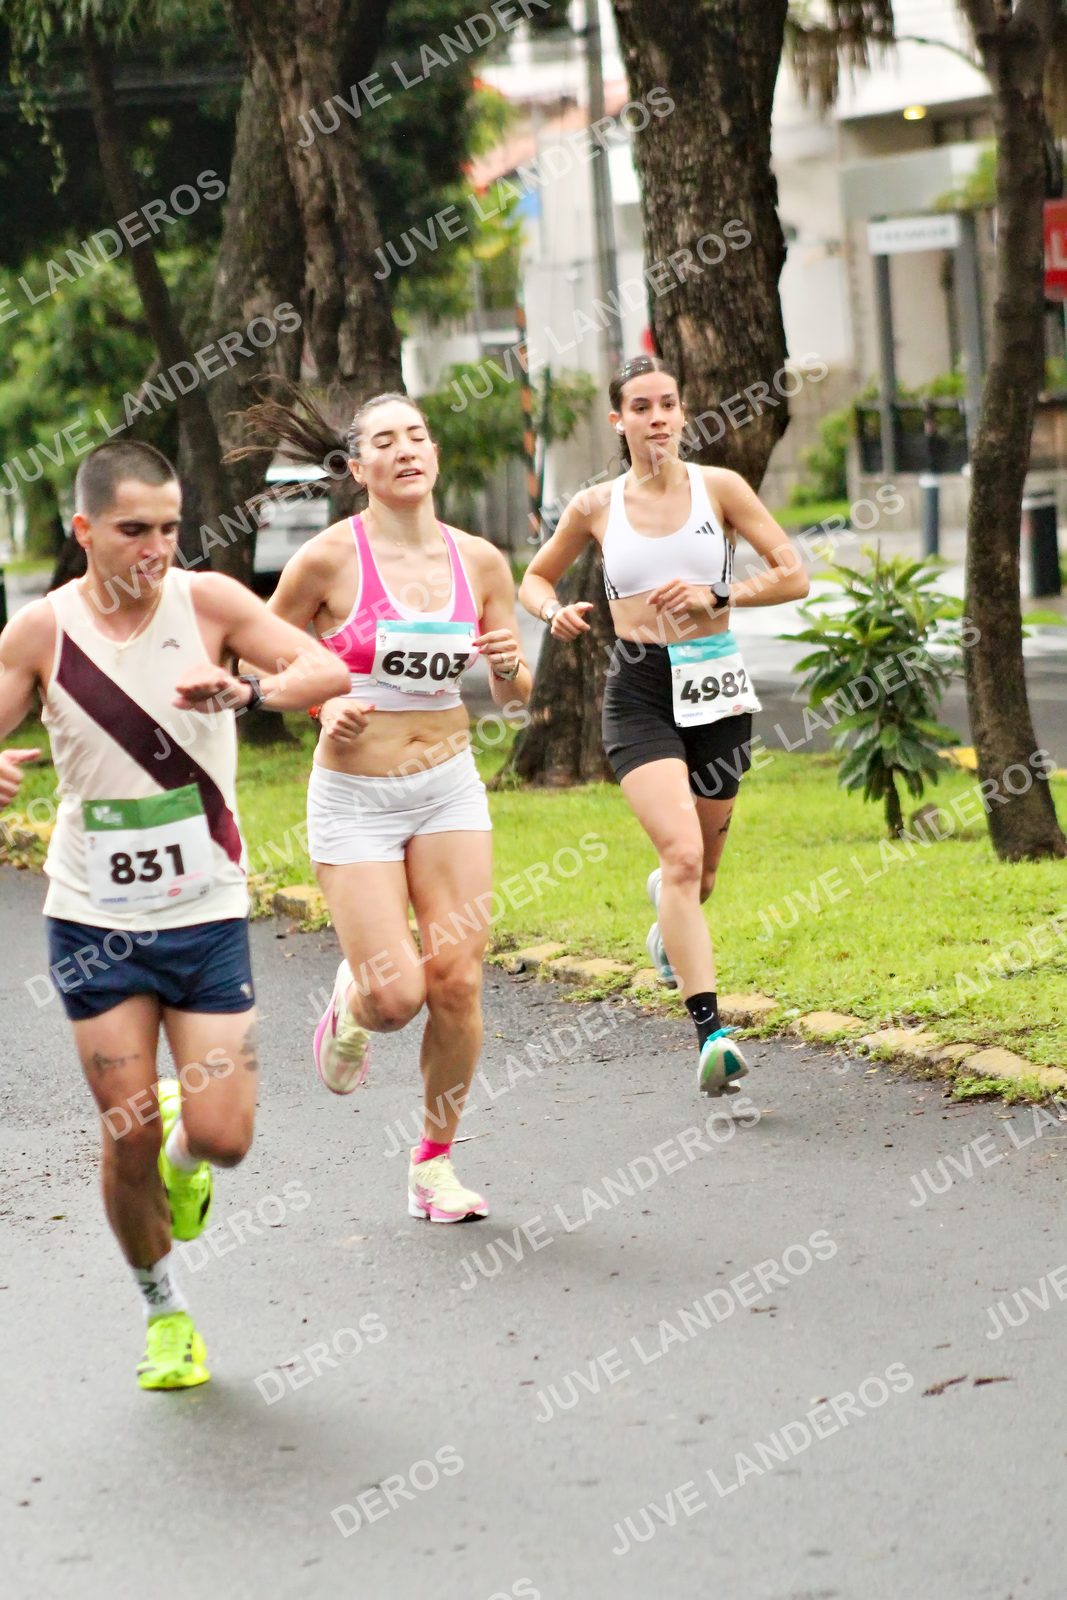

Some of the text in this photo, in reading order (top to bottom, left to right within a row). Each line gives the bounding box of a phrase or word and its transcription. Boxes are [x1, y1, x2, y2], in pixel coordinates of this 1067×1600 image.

[382, 651, 470, 681] 6303
[680, 669, 748, 704] 4982
[110, 844, 185, 884] 831
